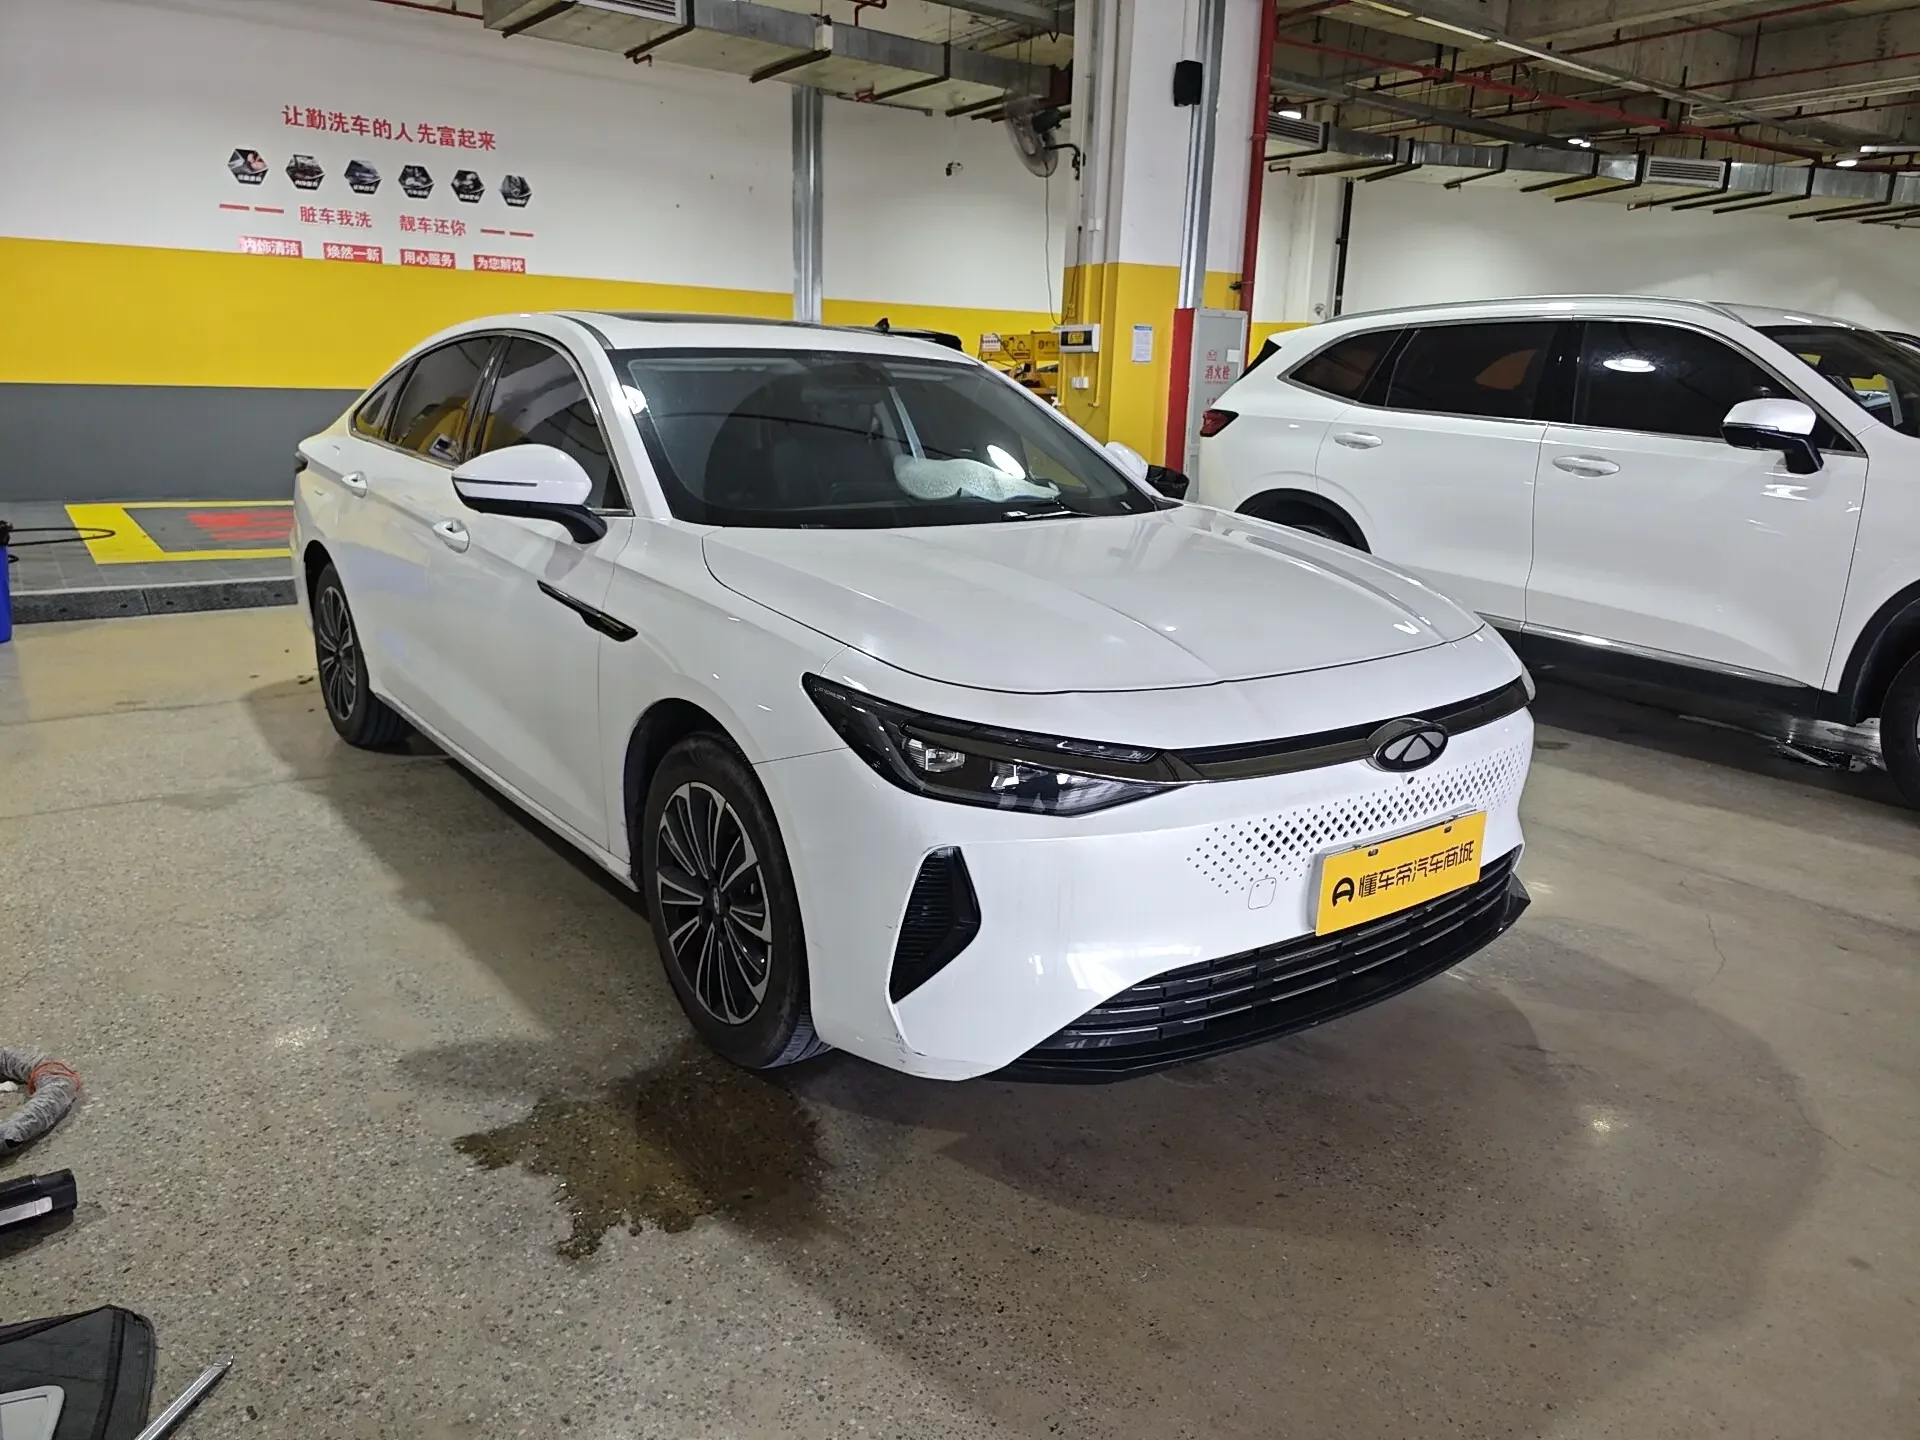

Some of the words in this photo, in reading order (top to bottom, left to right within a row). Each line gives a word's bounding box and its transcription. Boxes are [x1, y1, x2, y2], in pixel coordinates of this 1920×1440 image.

[282, 104, 497, 151] 让勤洗车的人先富起来
[300, 206, 373, 229] 脏车我洗
[400, 214, 467, 237] 靓车还你
[327, 245, 380, 262] 焕然一新
[404, 251, 454, 267] 用心服务
[477, 257, 524, 272] 为您解忧
[1205, 365, 1230, 380] 消火栓
[1358, 840, 1475, 898] 懂车帝汽车商城
